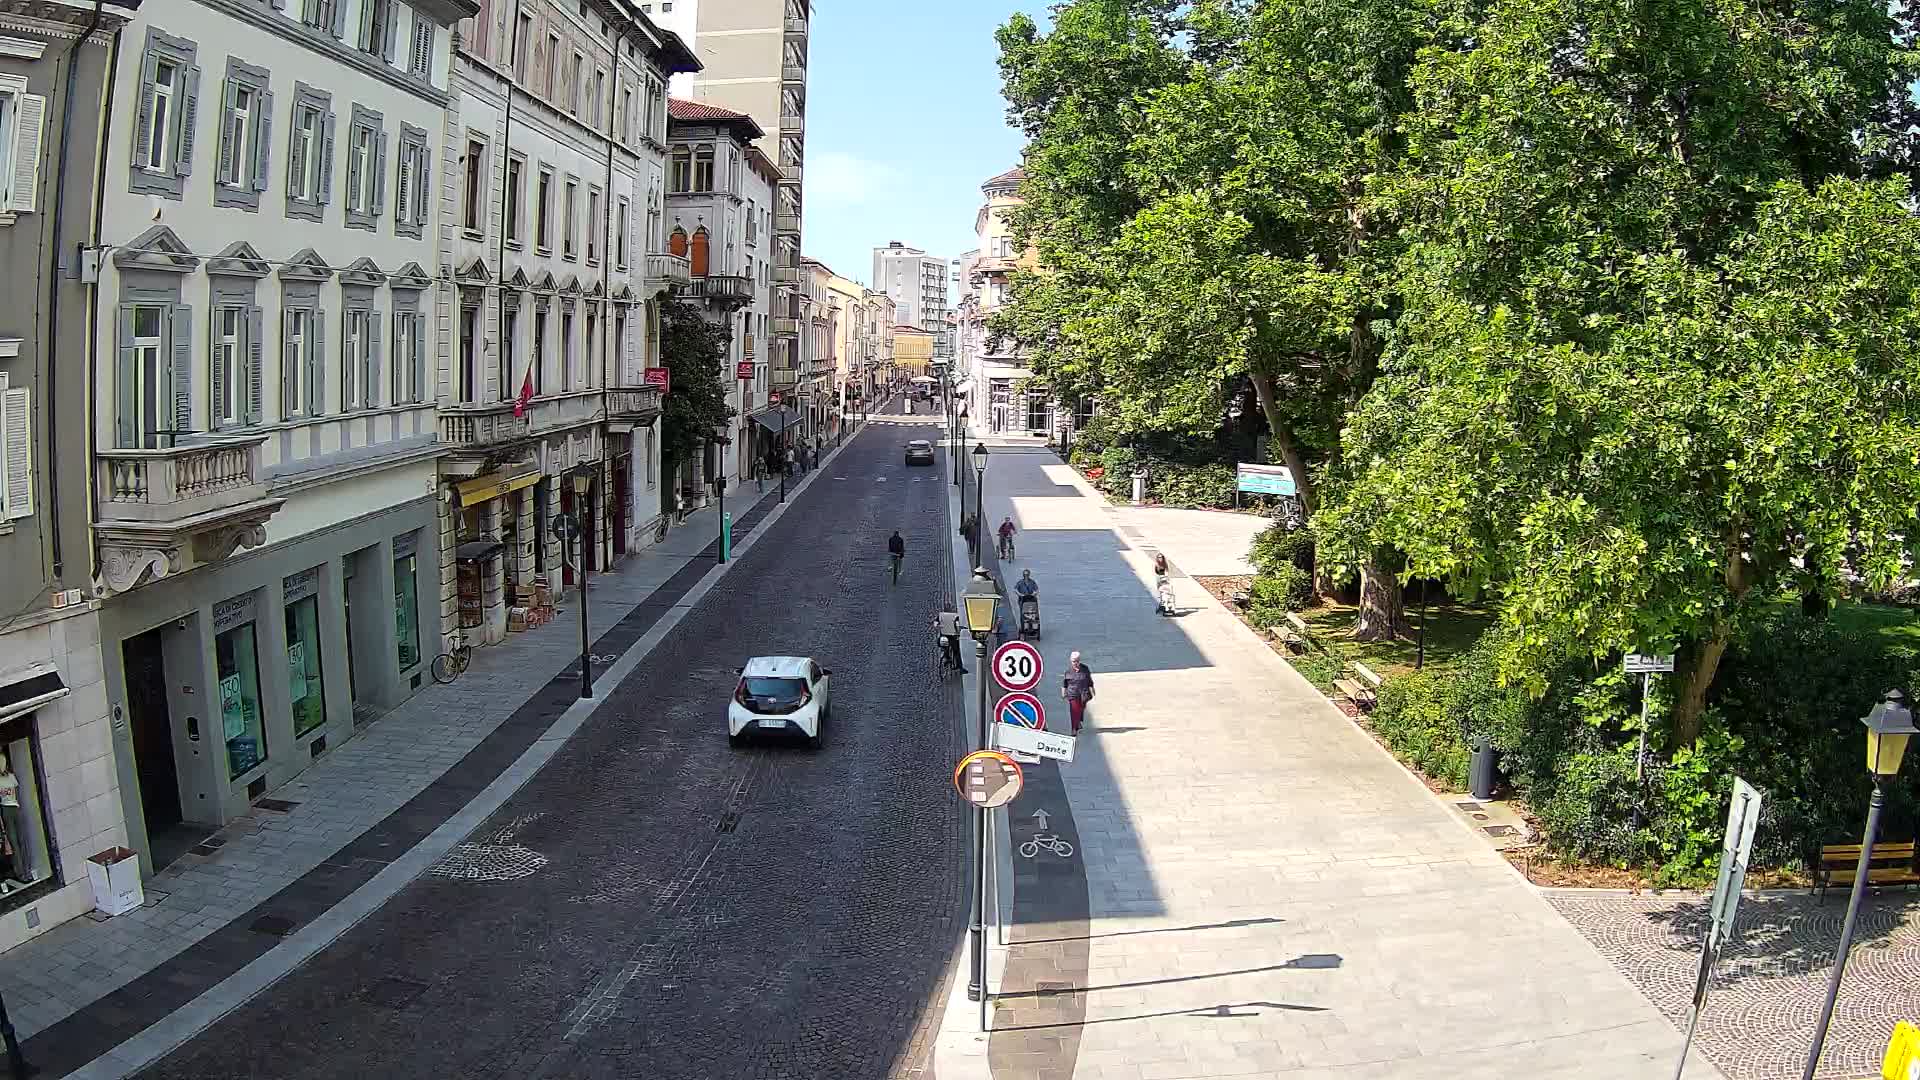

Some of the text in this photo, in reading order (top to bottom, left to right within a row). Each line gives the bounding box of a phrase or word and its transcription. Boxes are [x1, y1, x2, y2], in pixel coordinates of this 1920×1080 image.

[1005, 656, 1032, 678] 30
[221, 677, 240, 699] 130
[1037, 741, 1067, 755] Dante
